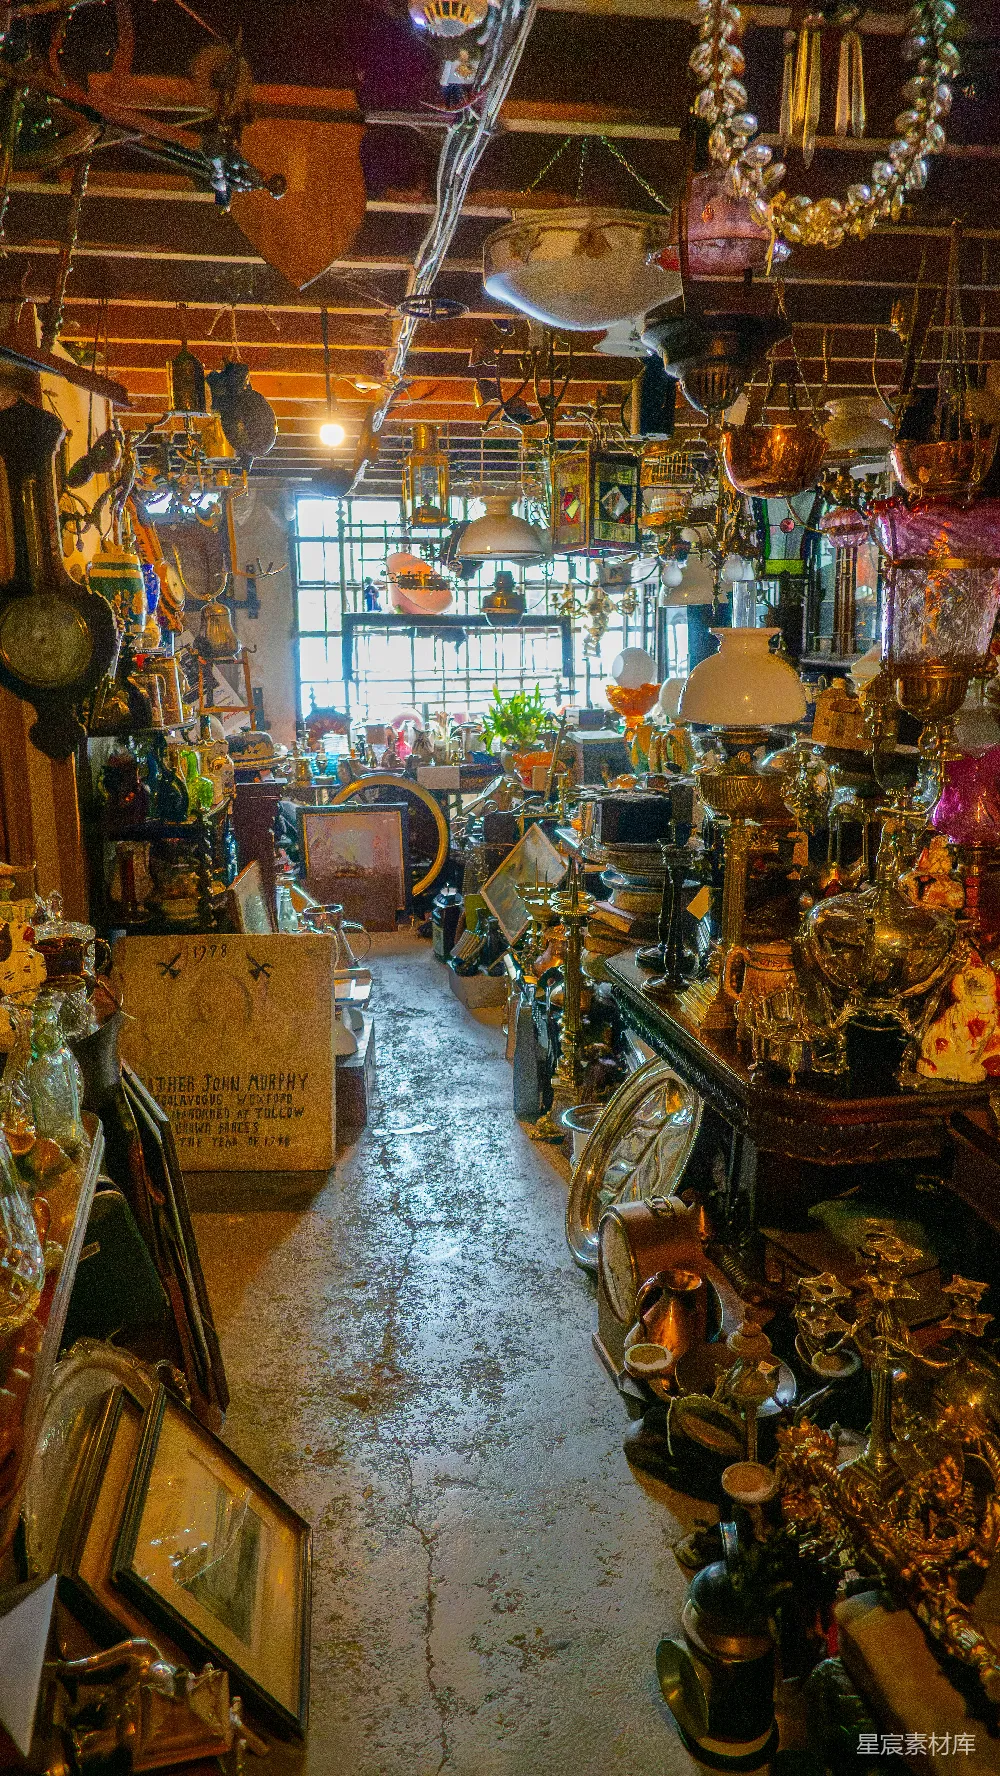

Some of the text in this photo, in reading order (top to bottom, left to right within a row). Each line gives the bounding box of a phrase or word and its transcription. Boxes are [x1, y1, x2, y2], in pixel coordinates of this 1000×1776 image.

[201, 1073, 241, 1092] JOHN
[248, 1072, 309, 1091] MURPHY
[254, 1106, 305, 1119] TULLOW
